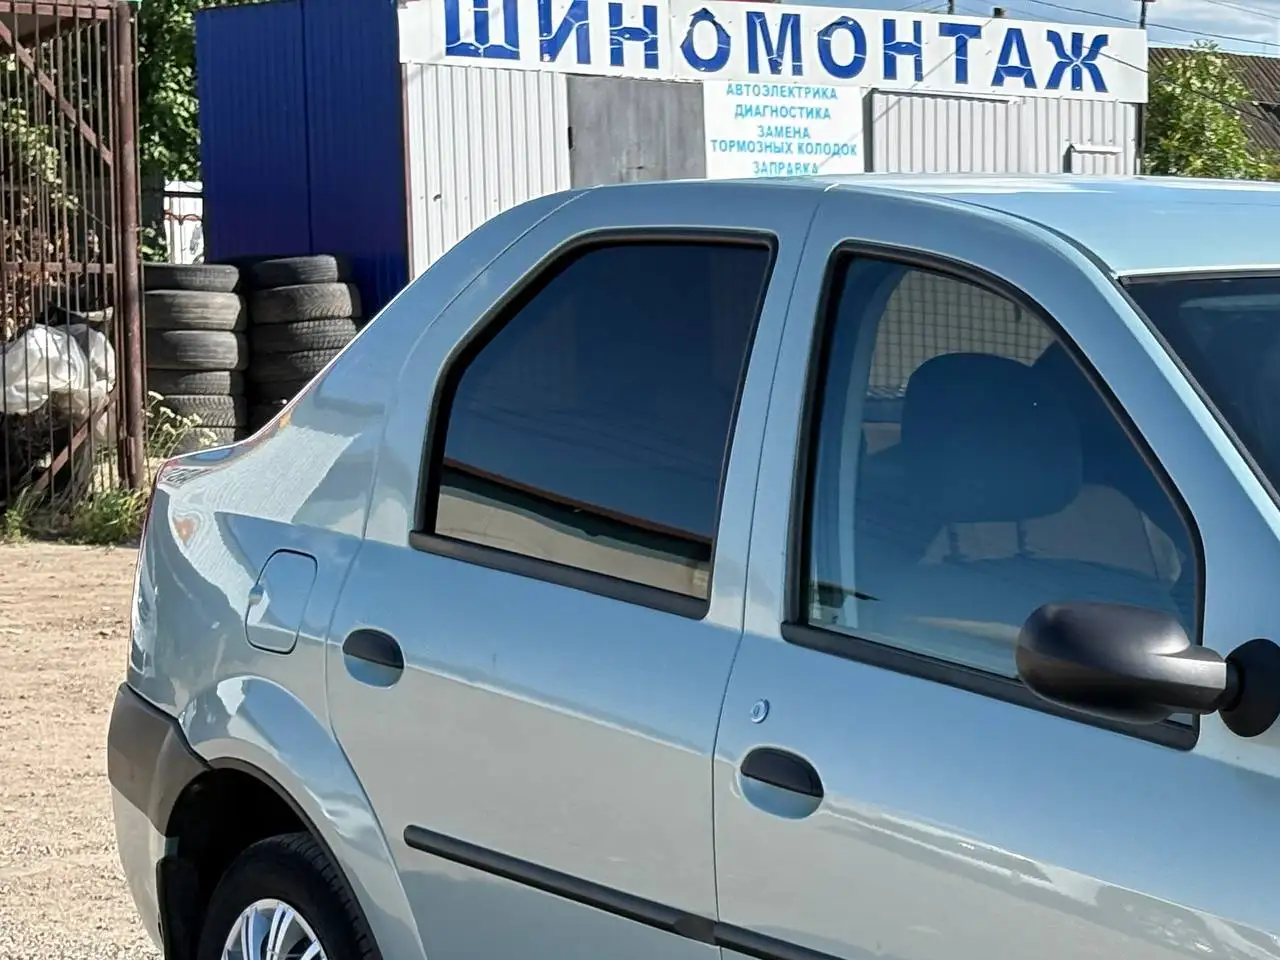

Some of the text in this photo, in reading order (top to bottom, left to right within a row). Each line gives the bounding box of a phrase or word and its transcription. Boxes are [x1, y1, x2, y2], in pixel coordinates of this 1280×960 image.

[444, 0, 1109, 93] ШИНОМОНТАЖ
[726, 84, 837, 99] АВТОЭЛЕКТРИКА
[734, 104, 831, 119] ДИАГНОСТИКА
[757, 125, 811, 139] ЗАМЕНА
[710, 140, 857, 157] ТОРМОЗНЫХ КОЛОДОК
[752, 161, 819, 175] ЗАПРАВКА
